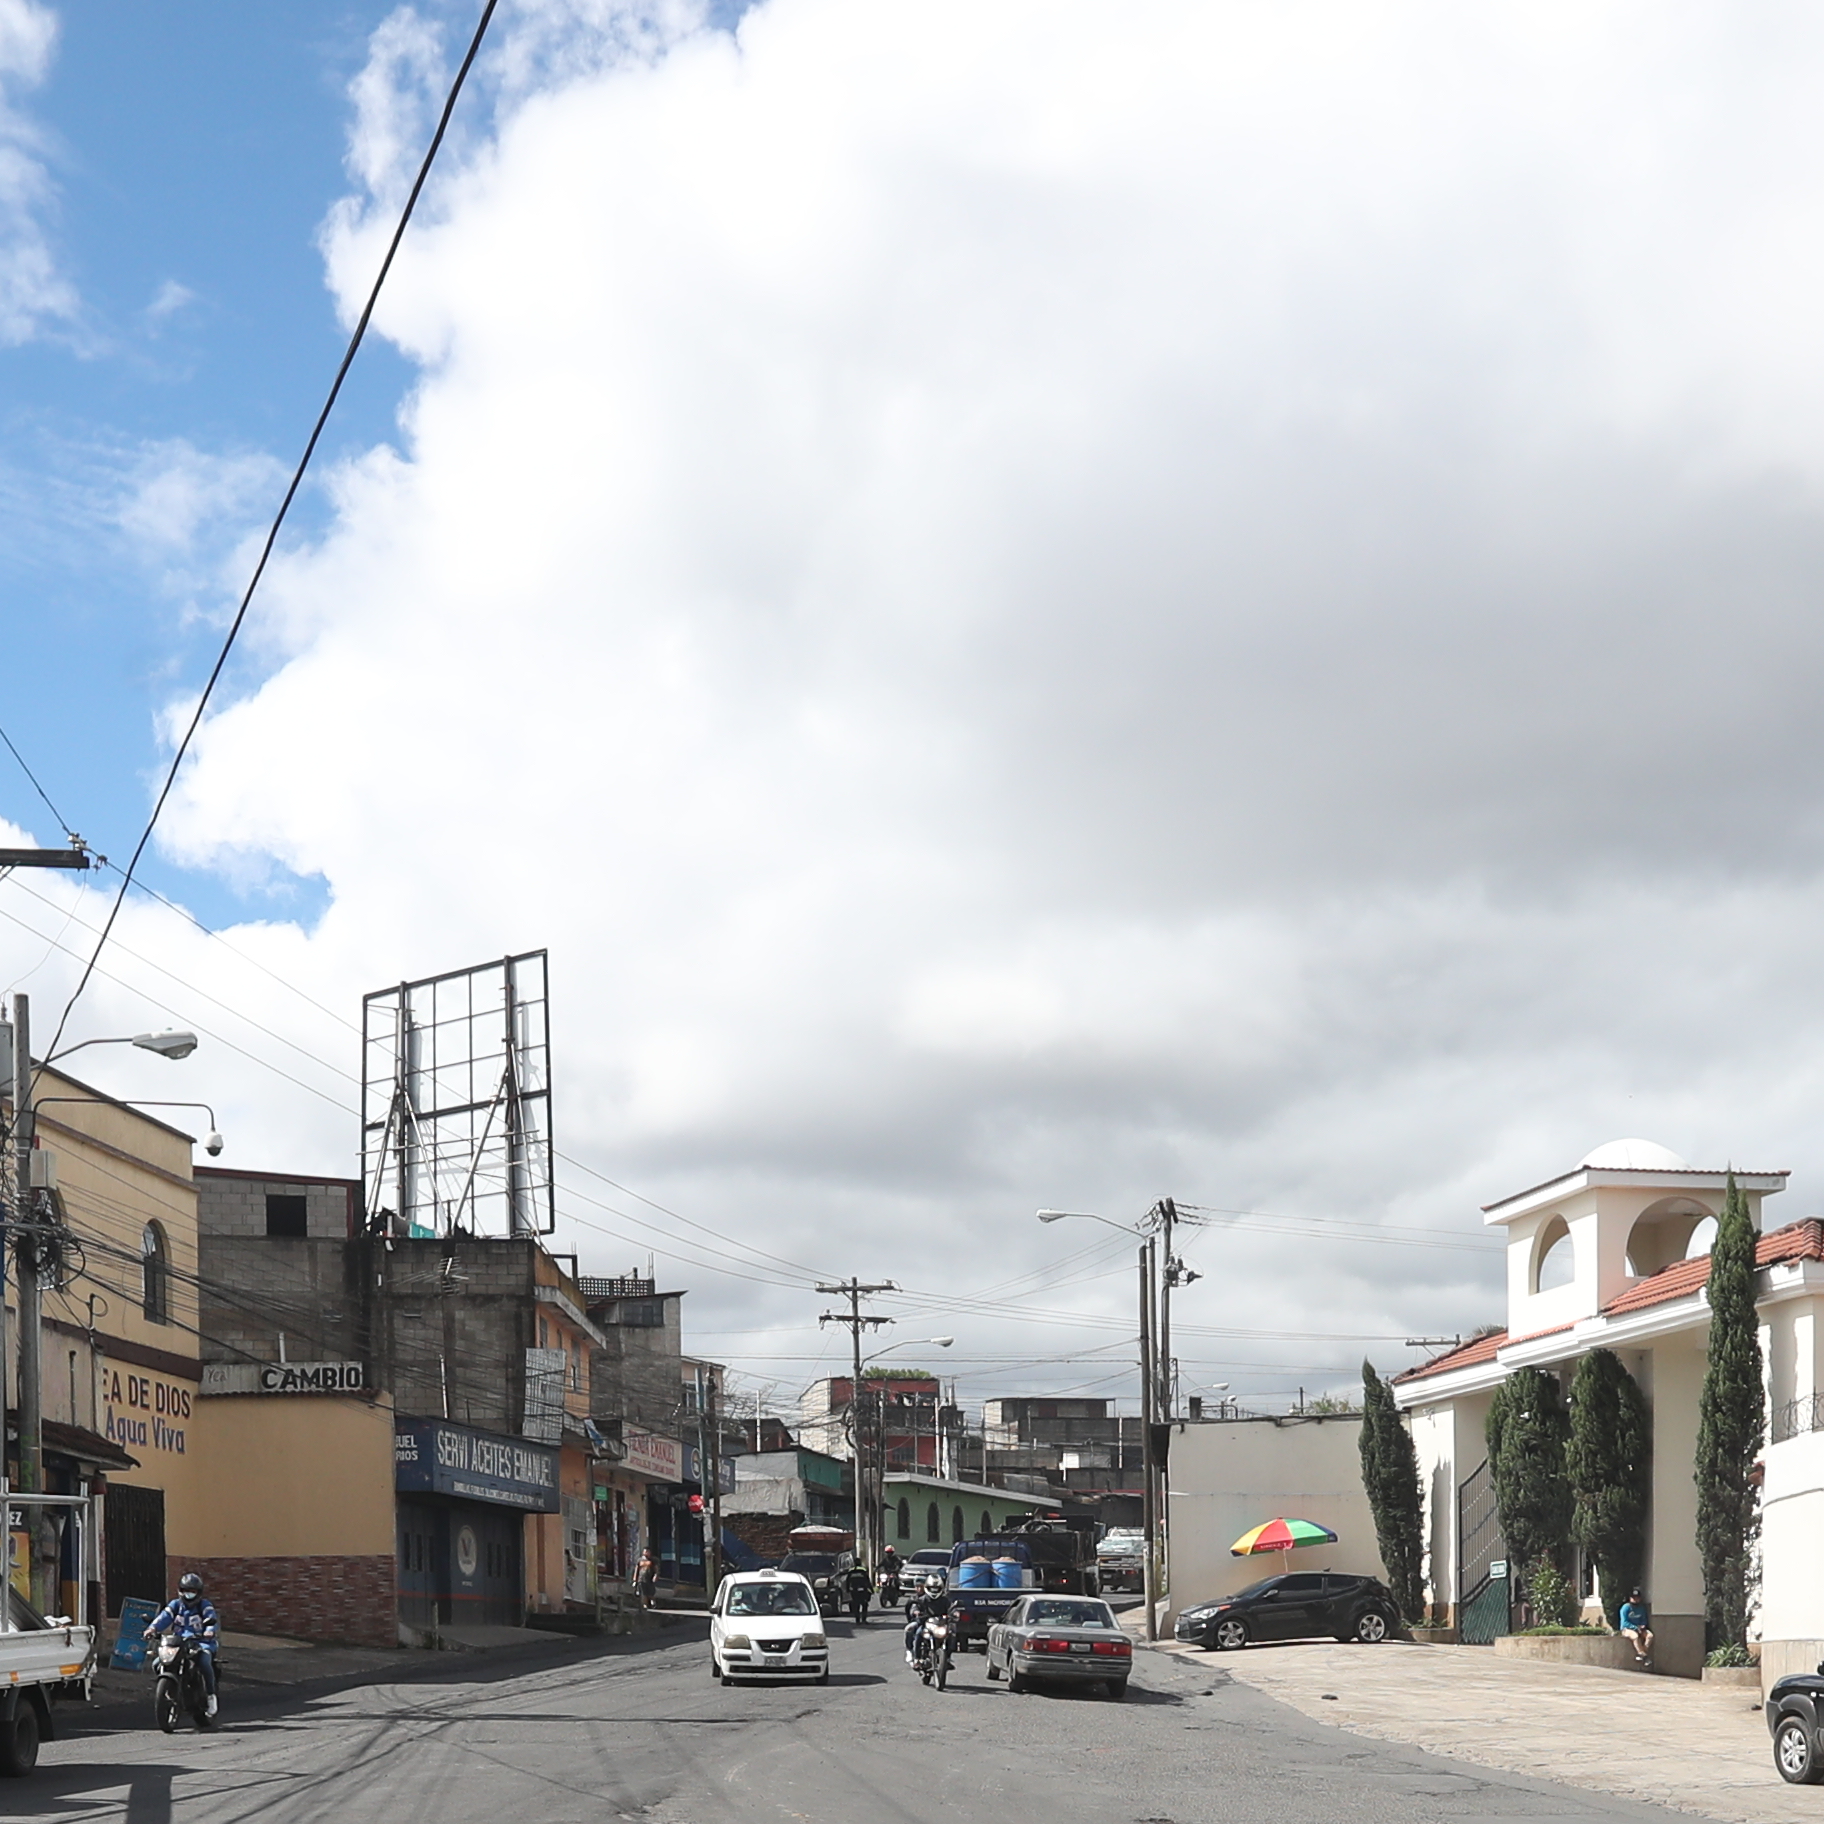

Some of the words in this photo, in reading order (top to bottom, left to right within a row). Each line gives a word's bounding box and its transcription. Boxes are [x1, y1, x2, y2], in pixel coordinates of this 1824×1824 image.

[128, 1373, 150, 1411] DE
[155, 1381, 192, 1420] DIOS
[105, 1405, 148, 1448] Agua
[151, 1415, 186, 1455] Viva
[437, 1429, 469, 1471] SERVI
[470, 1436, 512, 1480] ACEITES
